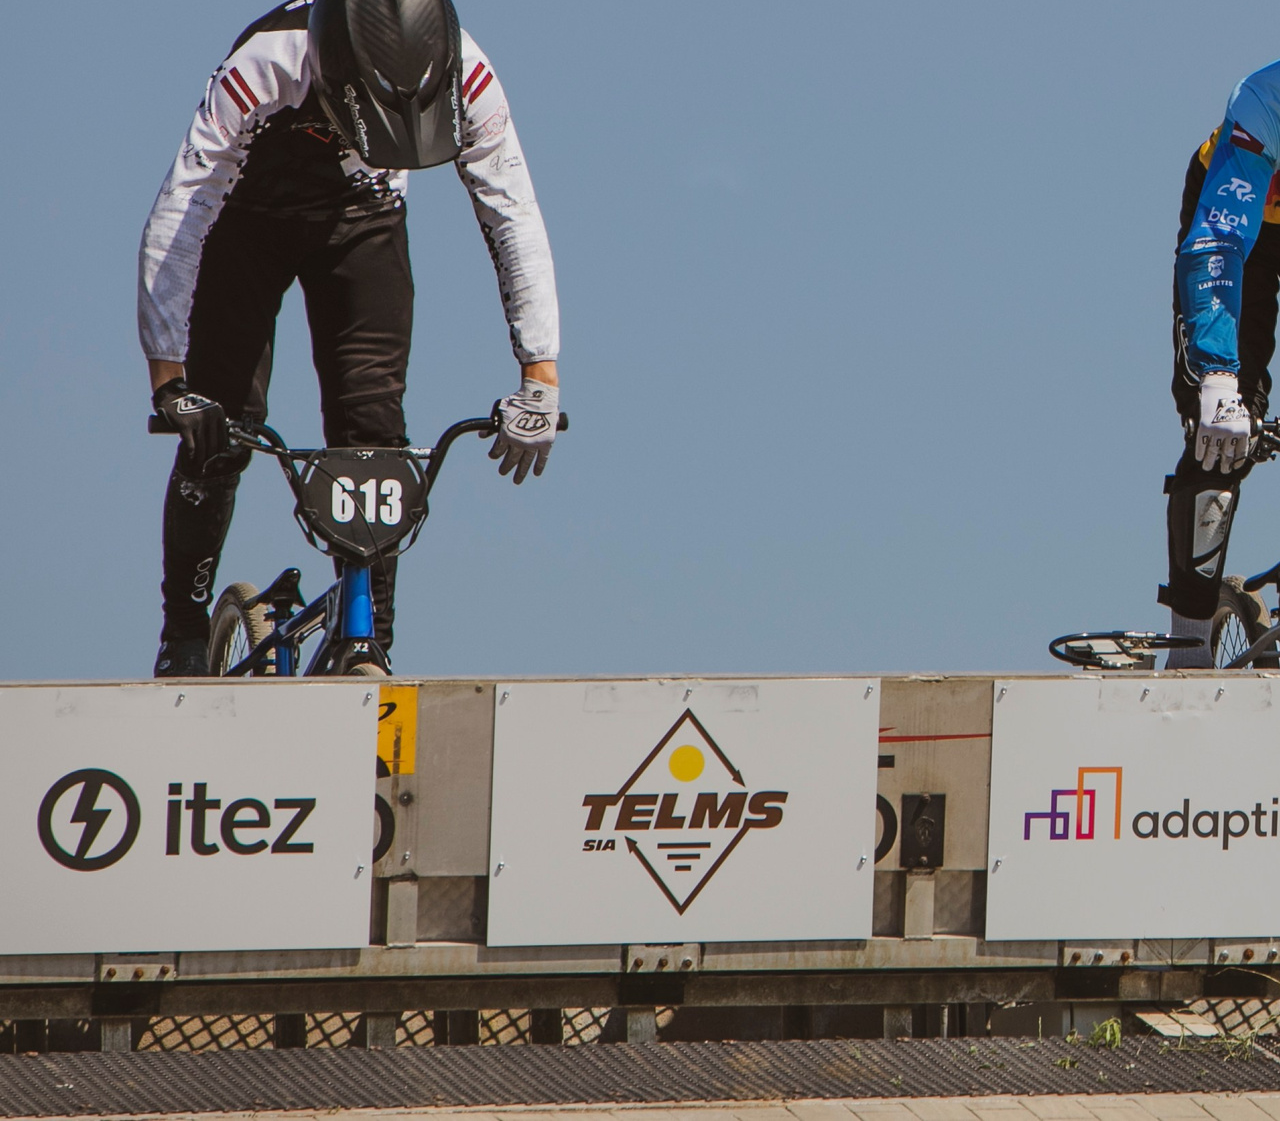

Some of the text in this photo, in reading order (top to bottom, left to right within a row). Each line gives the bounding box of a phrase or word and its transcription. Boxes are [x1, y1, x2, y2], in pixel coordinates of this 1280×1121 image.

[332, 476, 402, 526] 613
[353, 642, 369, 653] X2
[166, 782, 316, 856] itez
[582, 790, 789, 831] TELMS
[582, 839, 616, 852] SIA
